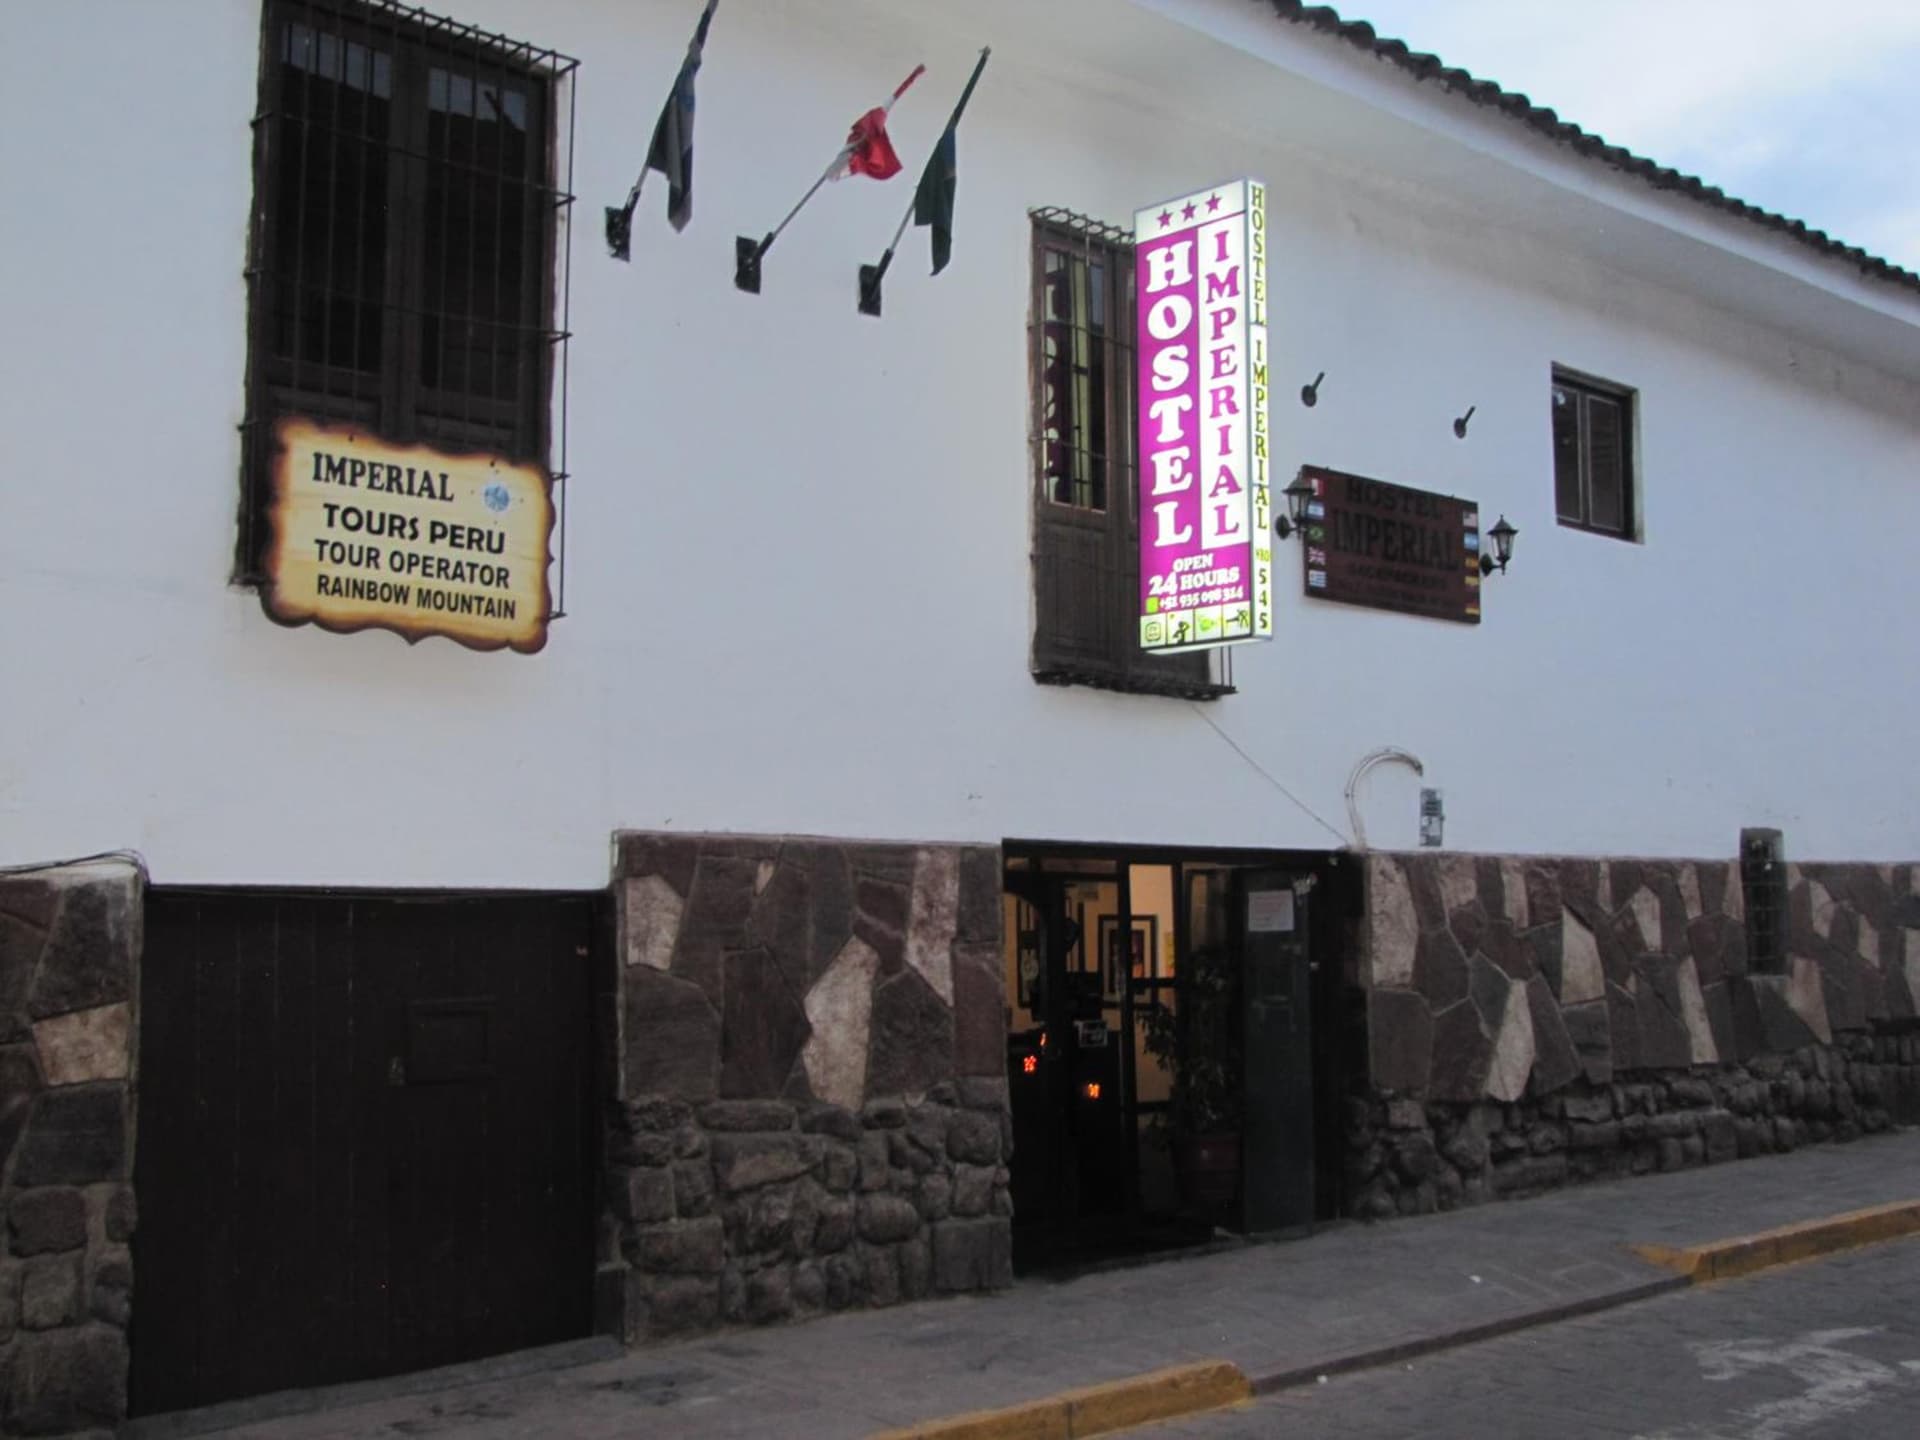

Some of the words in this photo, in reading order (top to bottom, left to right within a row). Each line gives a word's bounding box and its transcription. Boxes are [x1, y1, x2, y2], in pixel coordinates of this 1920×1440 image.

[1251, 184, 1266, 326] HOSTEL
[1146, 240, 1193, 547] HOSTEL
[1205, 230, 1242, 537] IMPERIAL
[1253, 339, 1268, 530] IMPERIAL
[312, 451, 454, 502] IMPERIAL
[323, 503, 419, 540] TOURS
[429, 520, 505, 554] PERU
[1333, 507, 1459, 571] IMPERIAL
[314, 538, 381, 569] TOUR
[388, 550, 510, 589] OPERATOR
[1149, 571, 1177, 596] 24
[1180, 566, 1240, 591] HOURS
[1173, 553, 1214, 573] OPEN
[317, 574, 410, 605] RAINBOW
[416, 587, 516, 620] MOUNTAIN
[1259, 567, 1268, 629] 545
